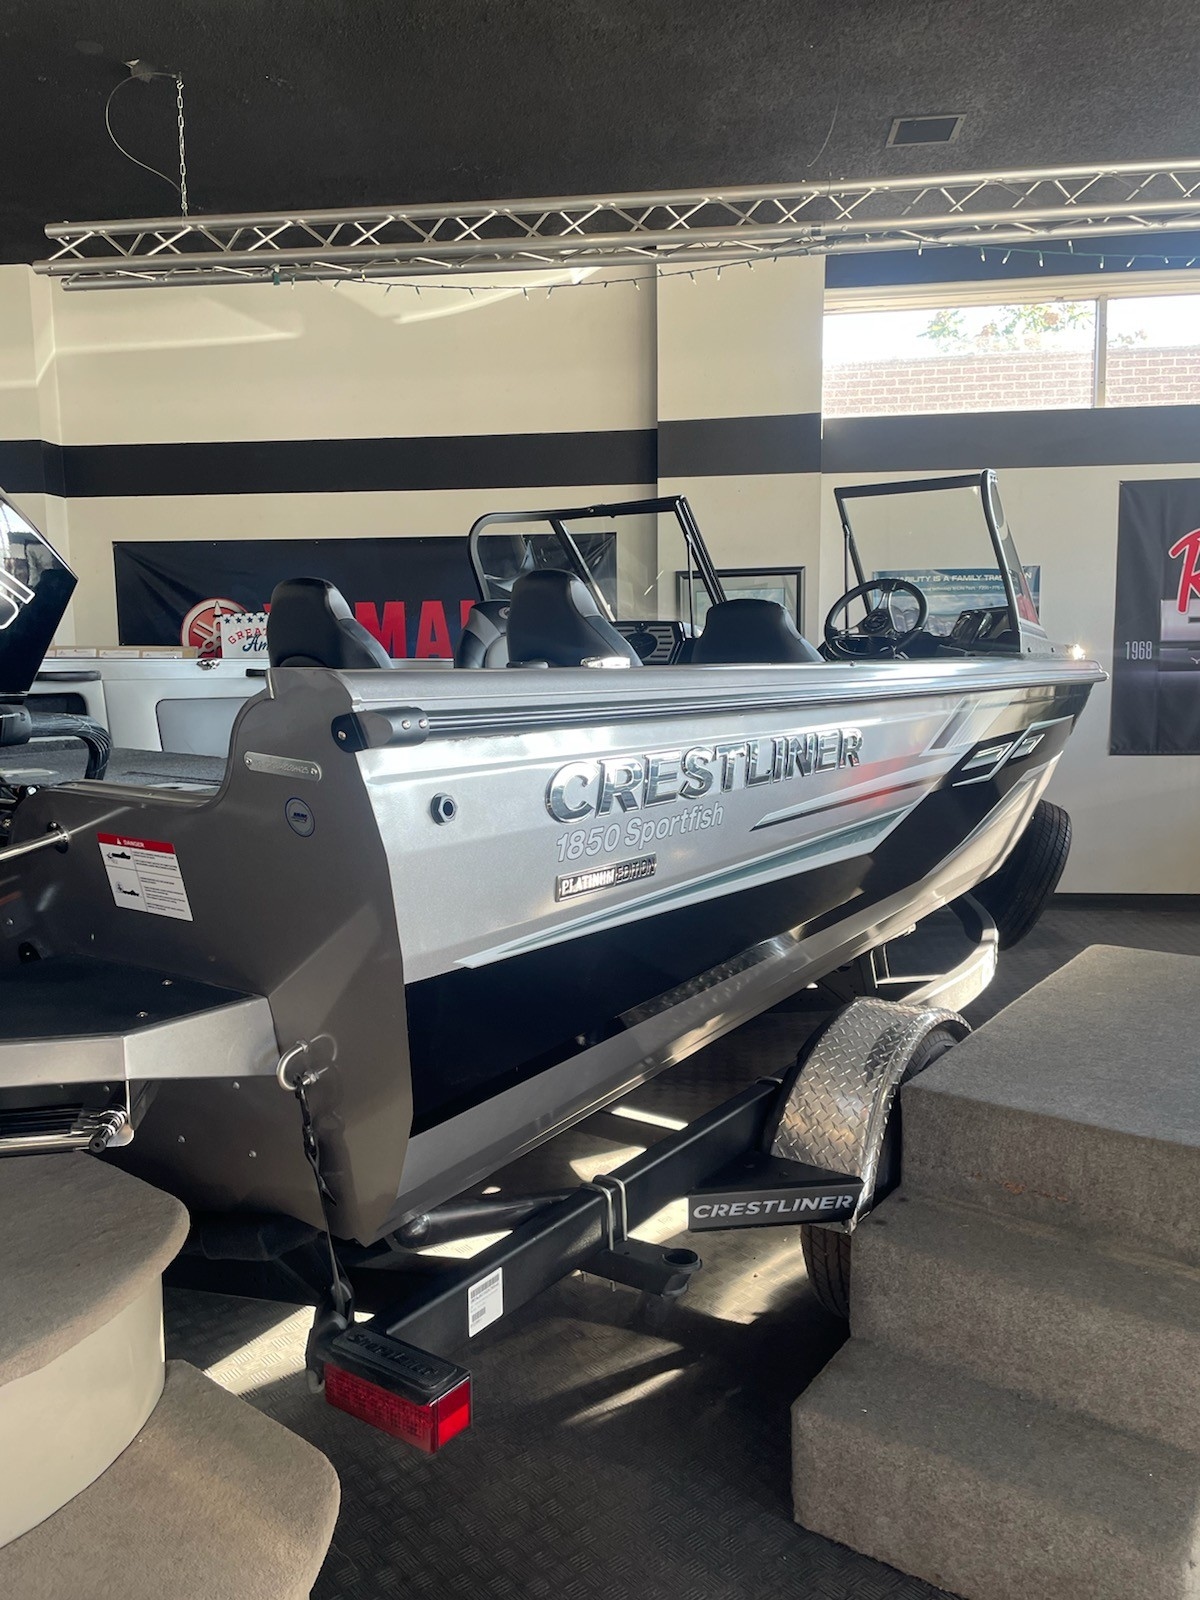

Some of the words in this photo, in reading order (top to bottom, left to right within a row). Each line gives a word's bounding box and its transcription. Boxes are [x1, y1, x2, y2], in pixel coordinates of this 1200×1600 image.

[951, 574, 982, 582] FAMILY
[1125, 640, 1153, 660] 1968
[545, 728, 864, 824] CRESTLINER
[123, 839, 145, 848] DANGER
[556, 822, 622, 862] 1850
[623, 801, 725, 851] Sportfish
[561, 868, 615, 896] PLATINUM
[615, 857, 657, 884] EDITION
[693, 1194, 854, 1219] CRESTLINER
